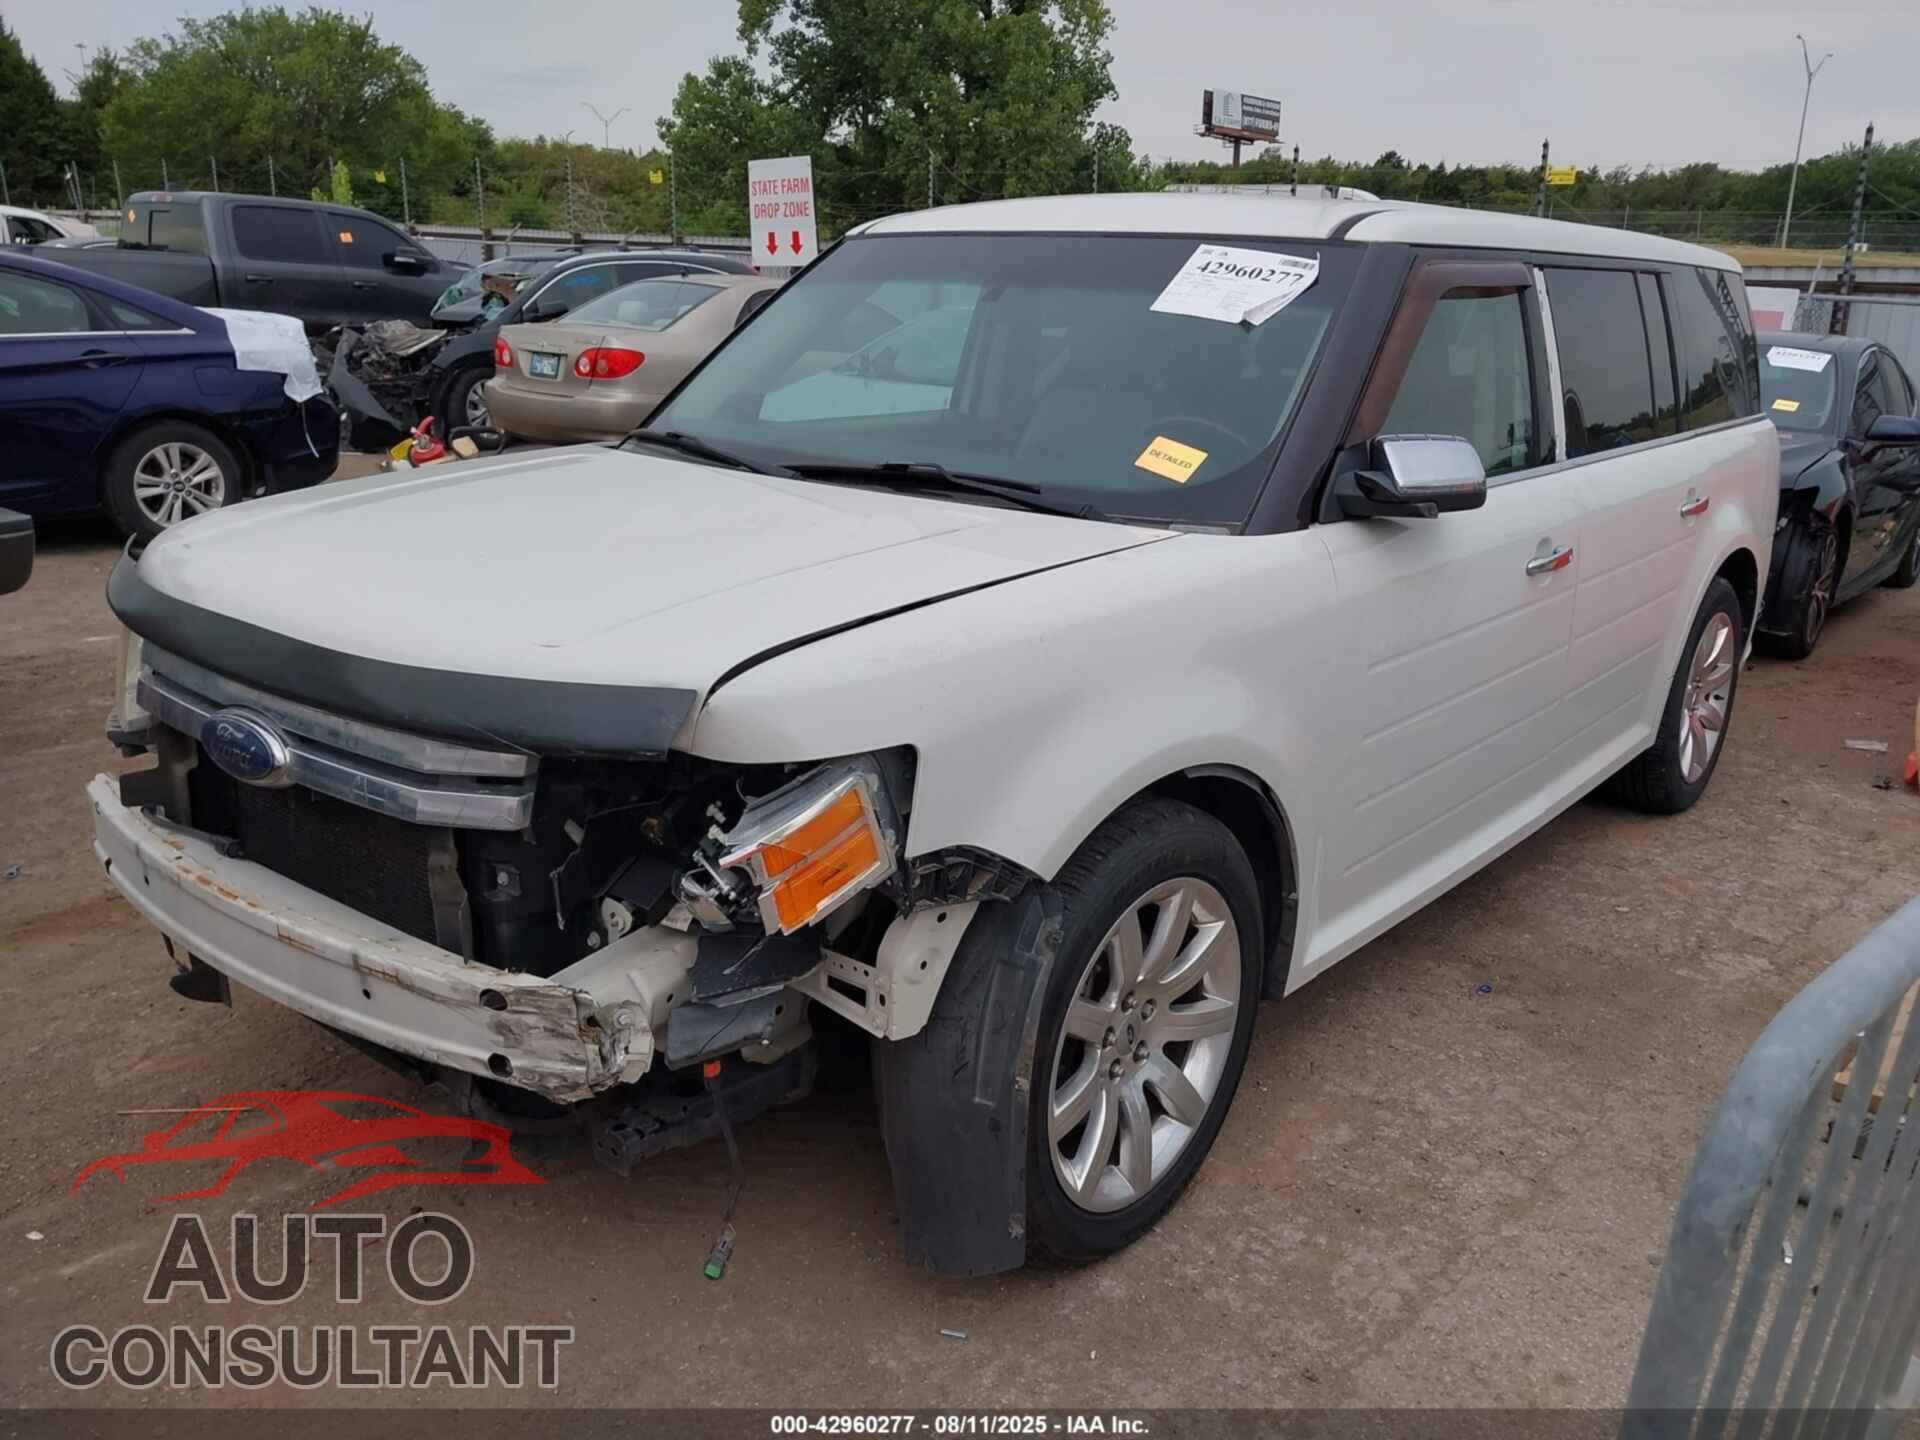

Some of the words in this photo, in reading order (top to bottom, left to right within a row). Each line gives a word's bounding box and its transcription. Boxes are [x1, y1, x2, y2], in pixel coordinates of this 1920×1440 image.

[751, 179, 779, 196] STATE
[781, 177, 810, 194] FARM
[754, 203, 781, 219] DROP
[783, 201, 810, 217] ZONE
[1197, 259, 1305, 287] 42960277
[1149, 449, 1193, 469] DETAILED
